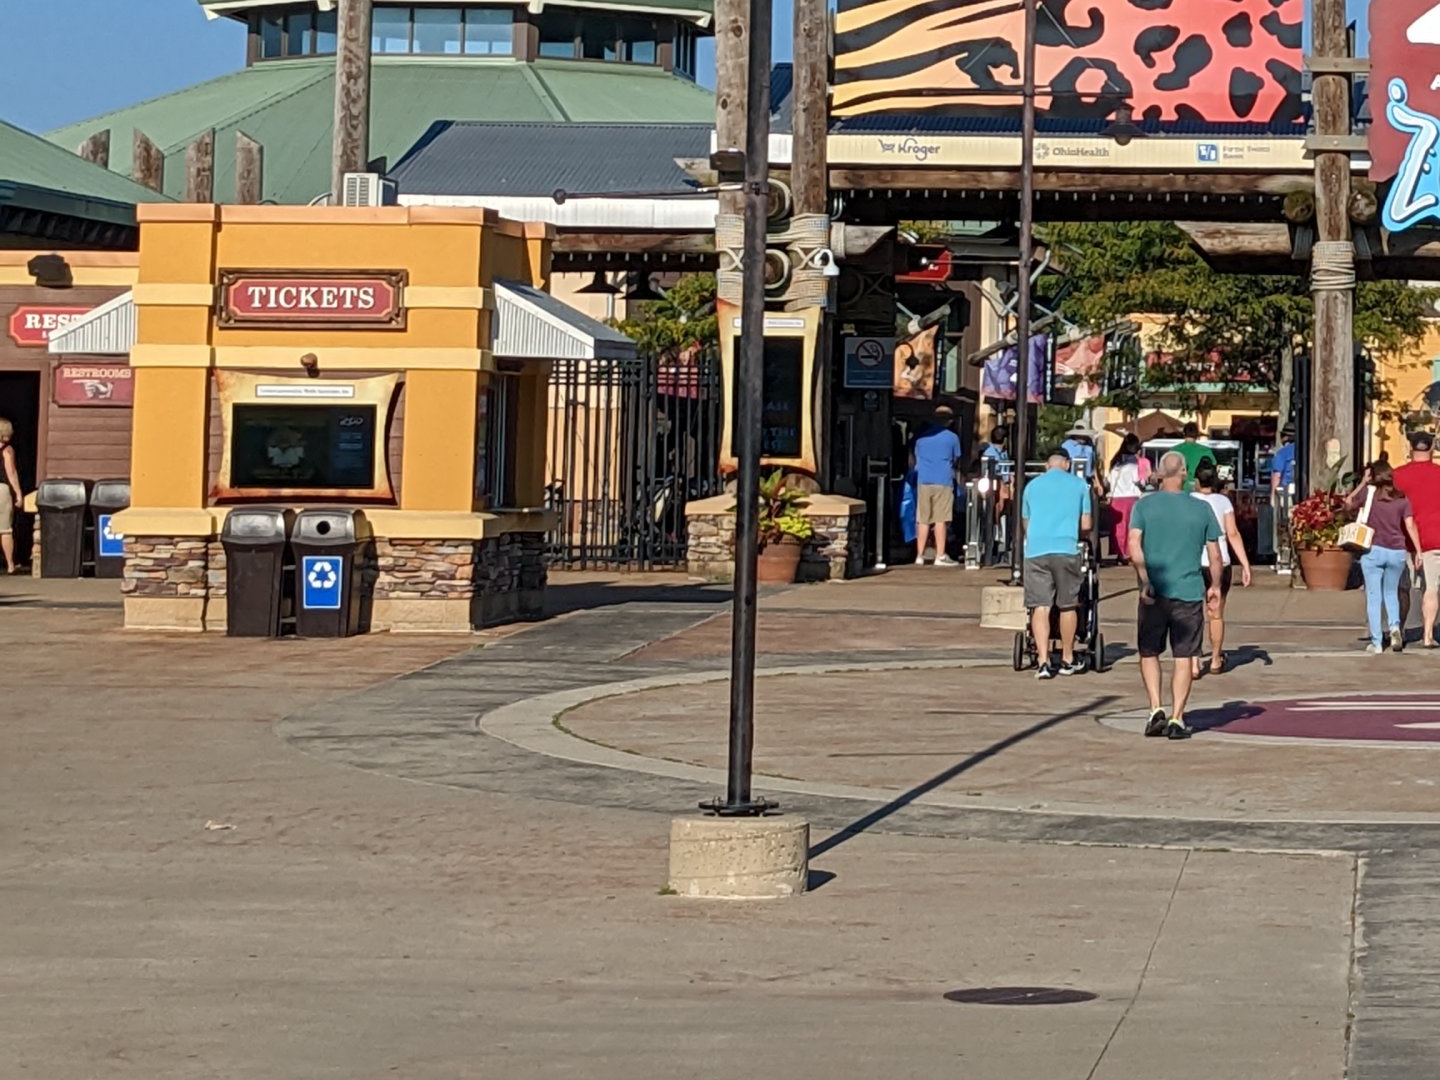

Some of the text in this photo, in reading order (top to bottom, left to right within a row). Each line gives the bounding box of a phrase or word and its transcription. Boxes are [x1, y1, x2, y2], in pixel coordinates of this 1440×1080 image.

[898, 137, 941, 161] Kroger
[248, 286, 375, 309] TICKETS
[63, 367, 131, 379] RESTROOMS
